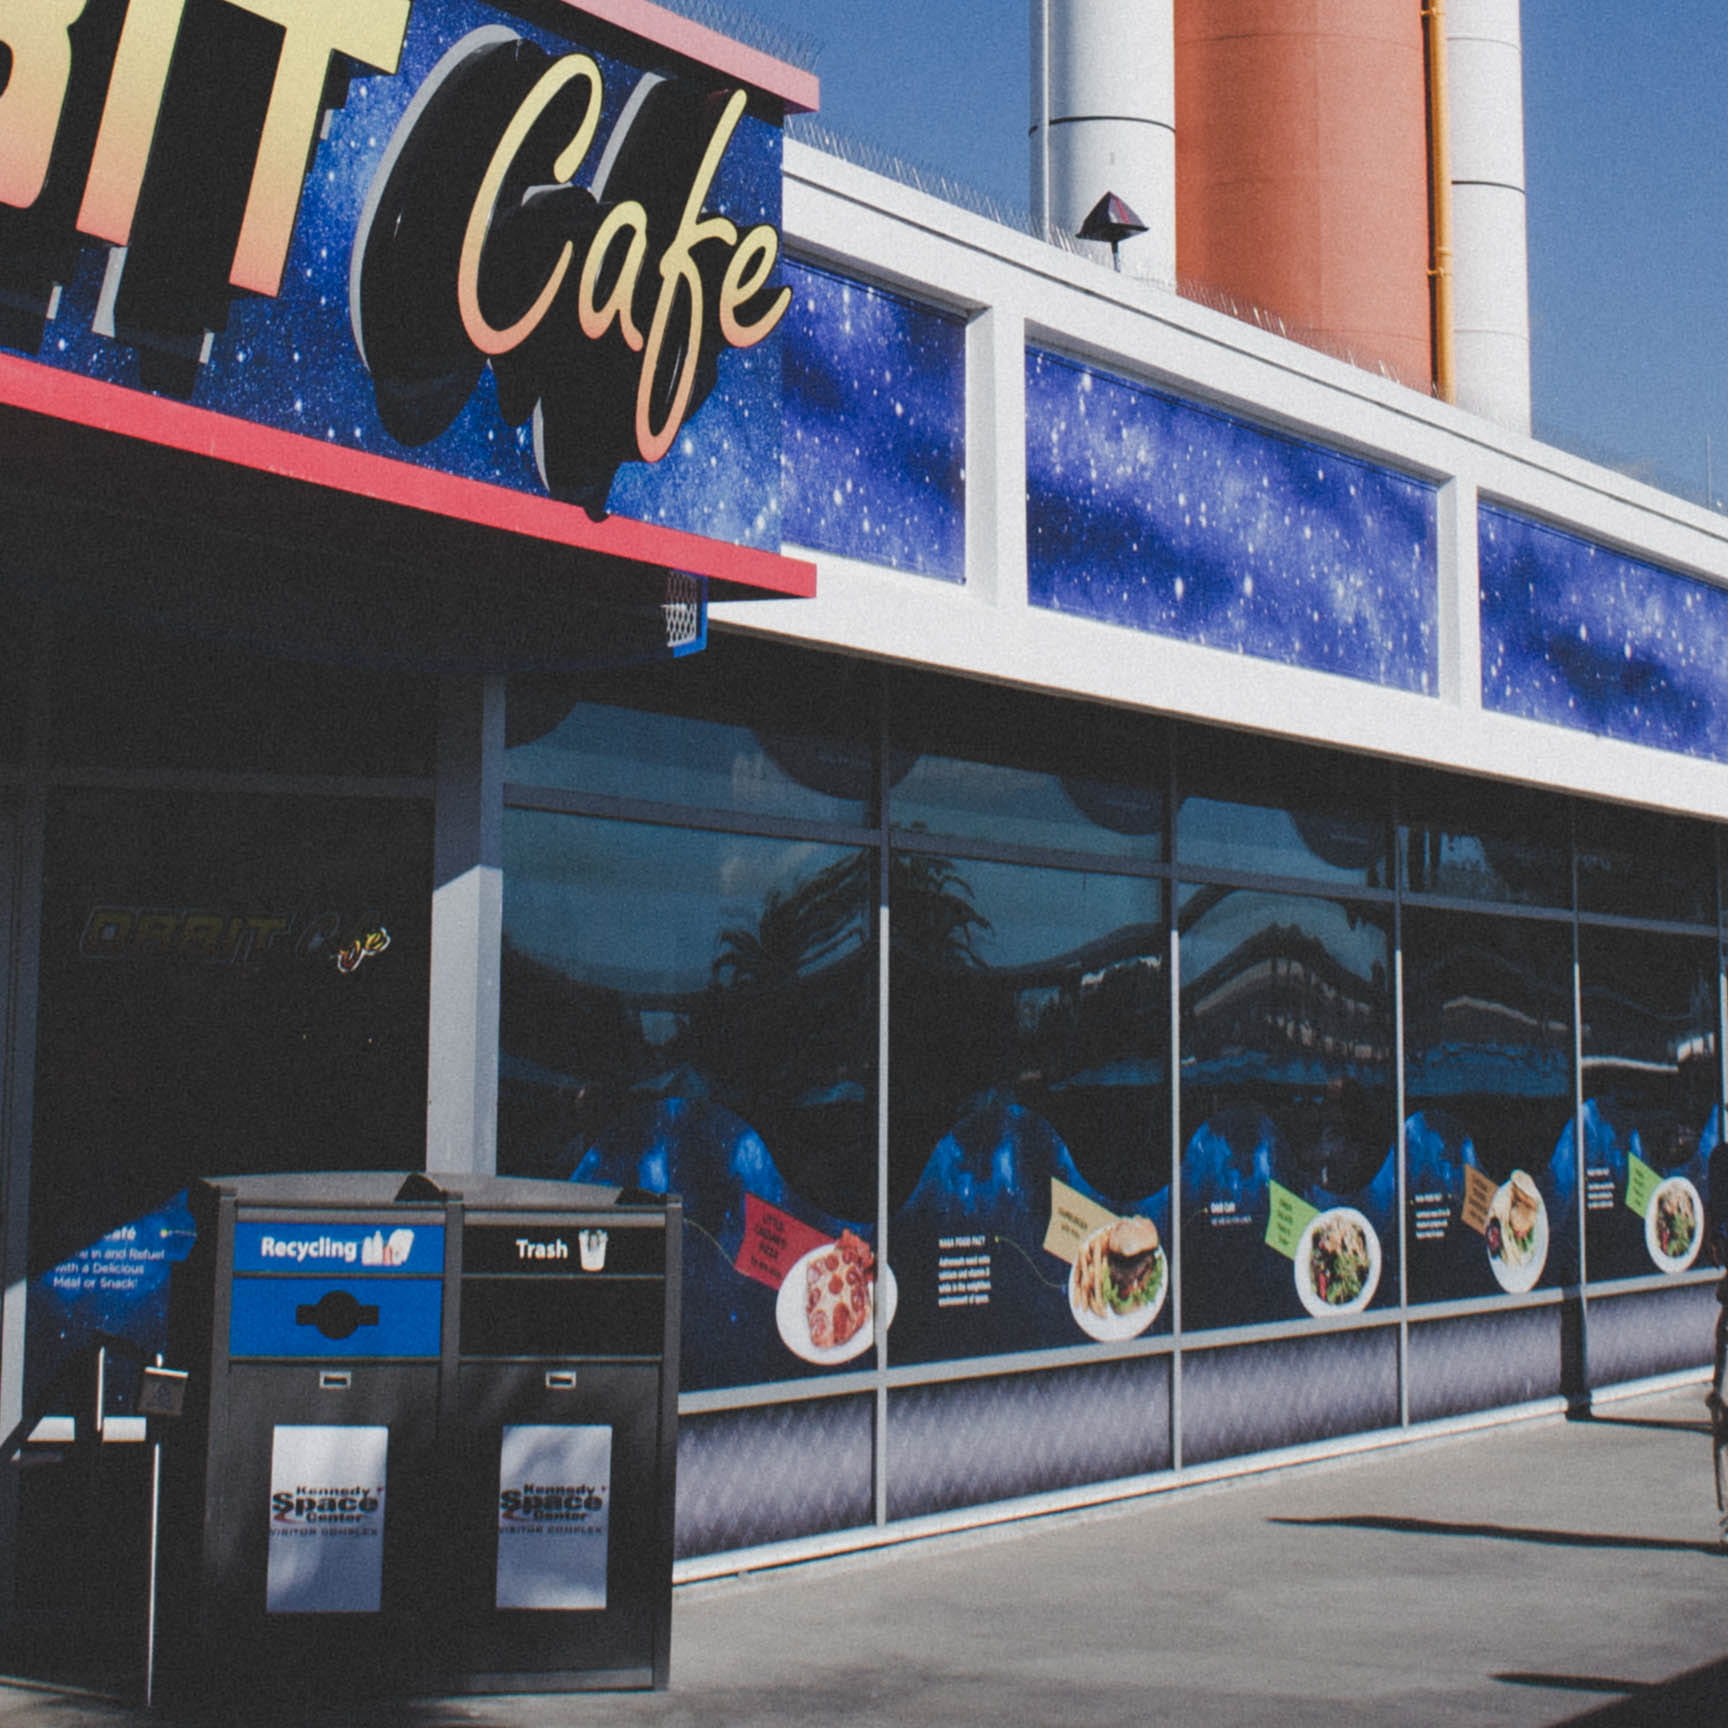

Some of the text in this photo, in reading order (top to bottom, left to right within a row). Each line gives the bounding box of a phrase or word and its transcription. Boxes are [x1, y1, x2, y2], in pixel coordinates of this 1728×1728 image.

[457, 53, 793, 463] Cafe
[104, 1249, 127, 1260] and
[129, 1248, 165, 1261] Refuel
[261, 1236, 357, 1262] Recycling
[515, 1238, 569, 1260] Trash
[93, 1262, 145, 1275] Delicious
[53, 1276, 81, 1288] Meal
[83, 1279, 96, 1288] or
[296, 1484, 371, 1497] Kennedy
[523, 1483, 596, 1495] Kennedy
[272, 1490, 379, 1516] Space
[501, 1489, 603, 1515] Space
[305, 1511, 363, 1523] Center
[532, 1510, 588, 1521] Center
